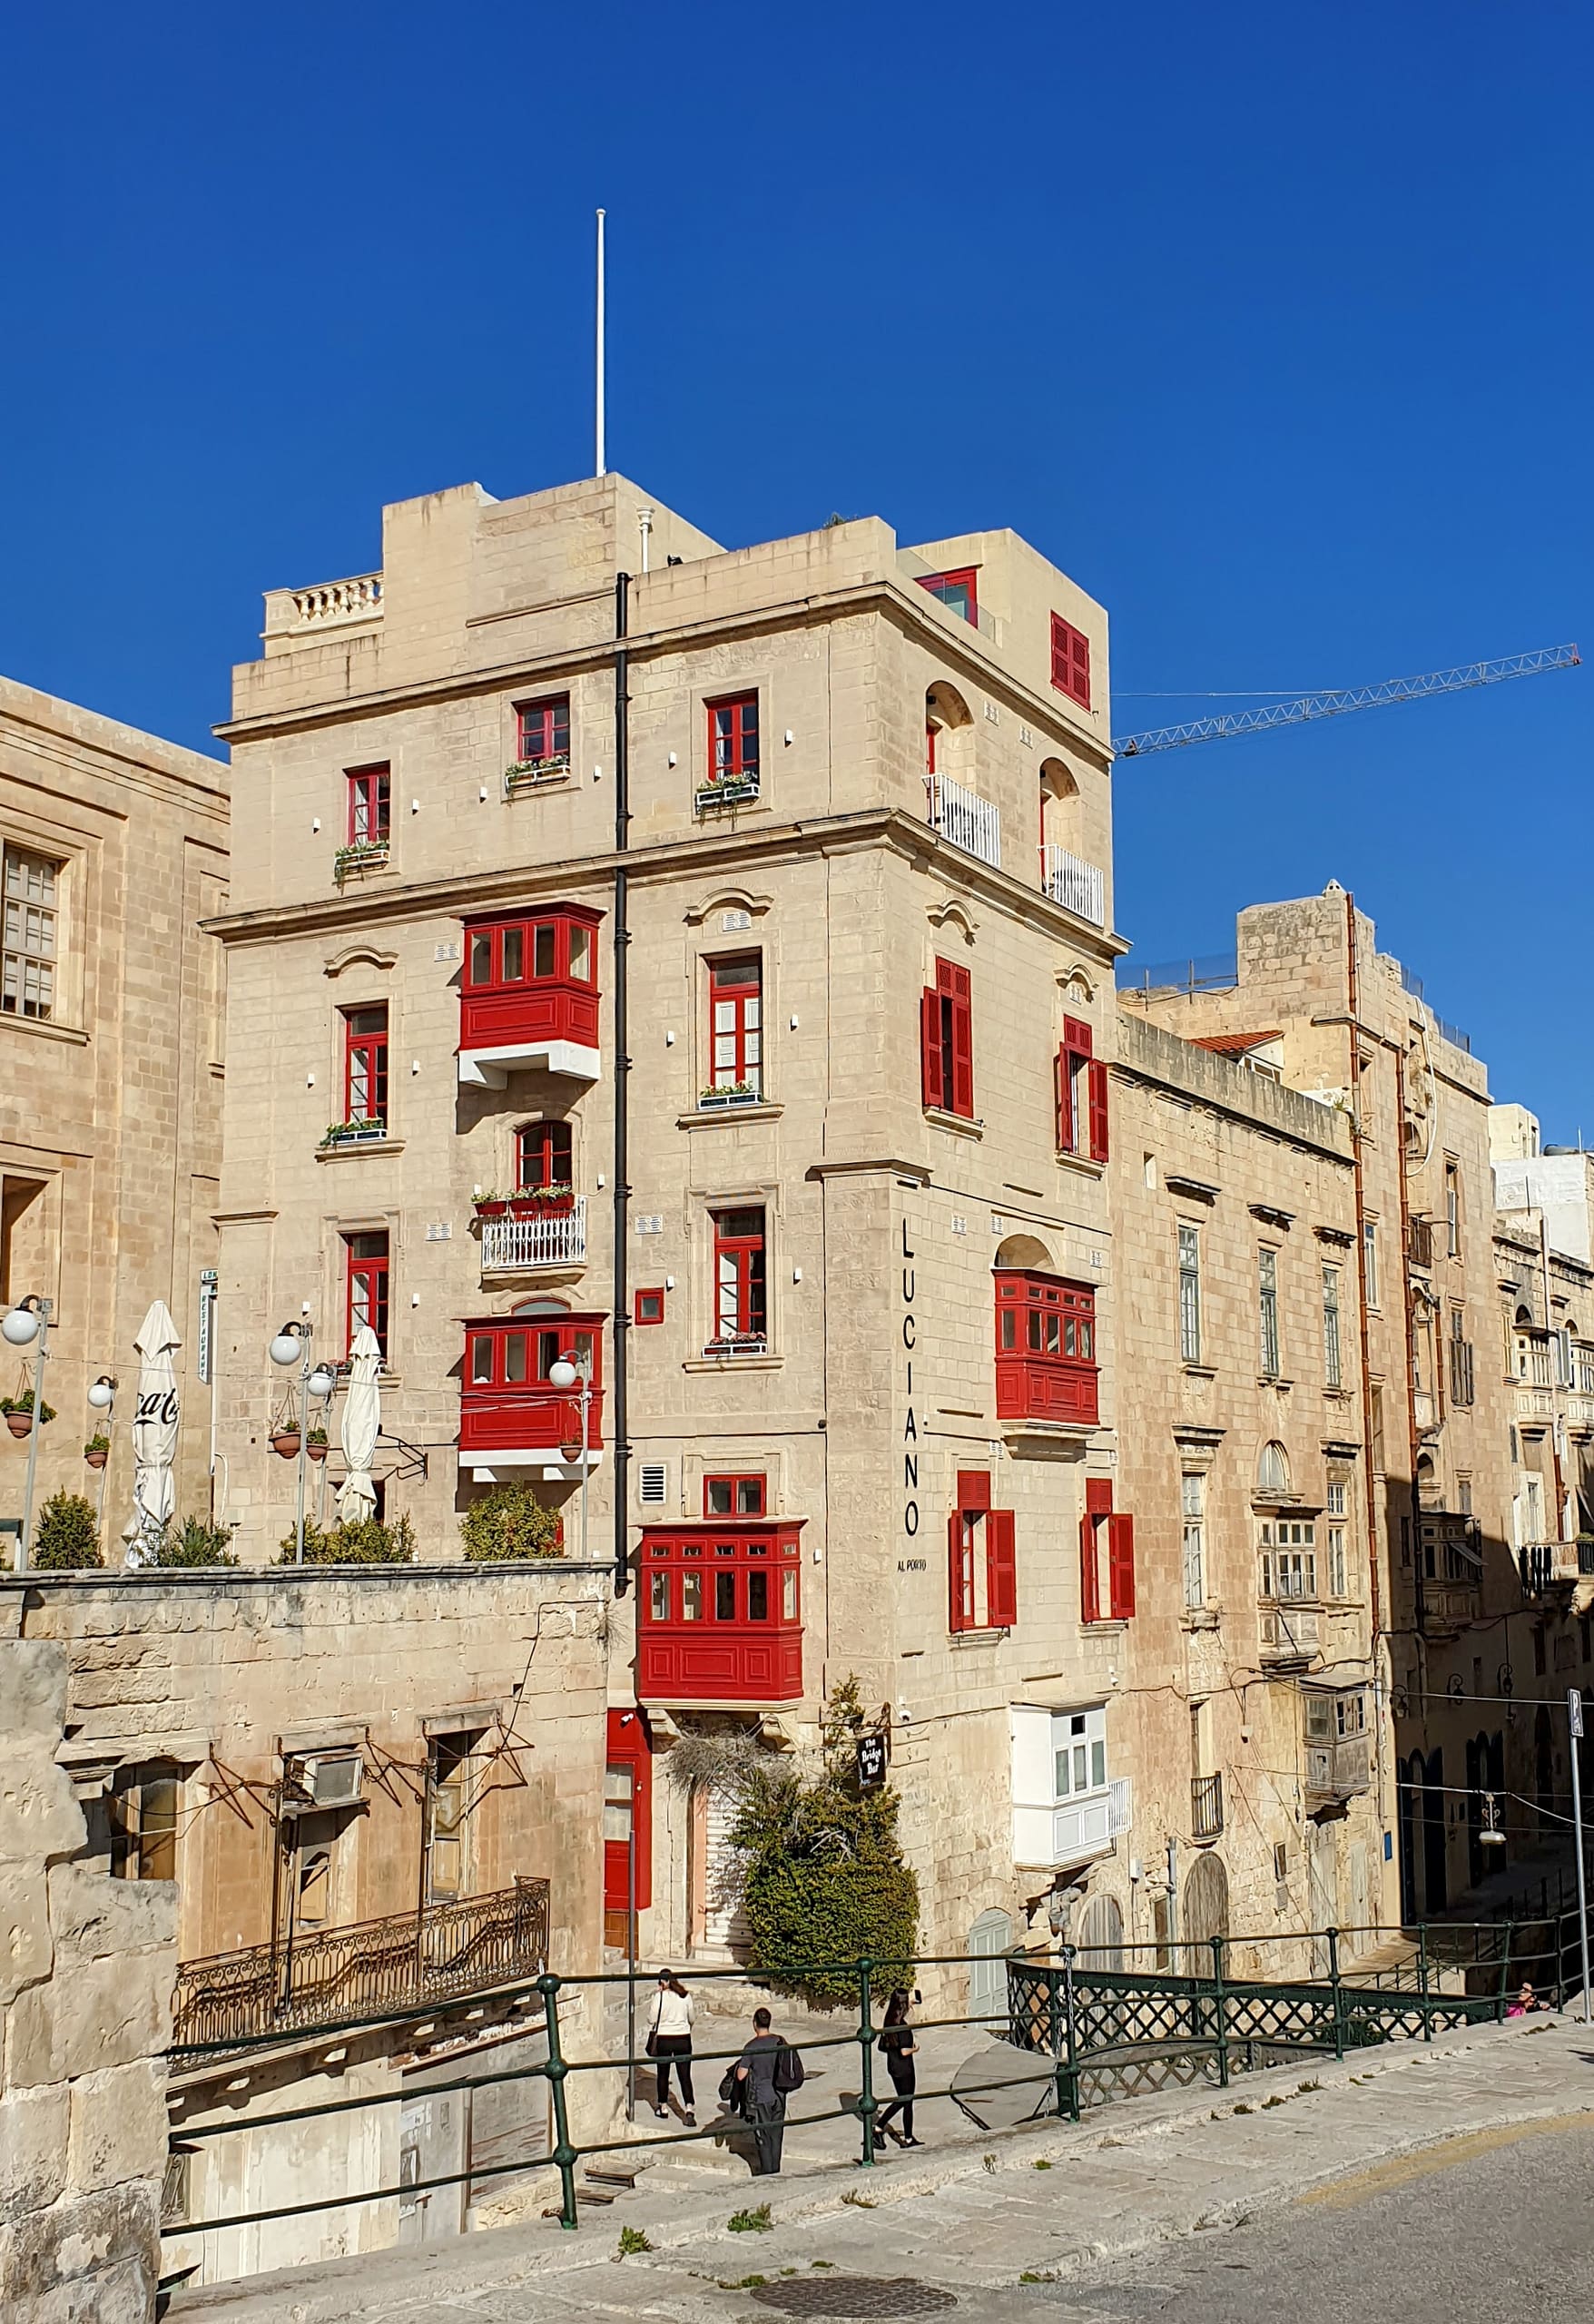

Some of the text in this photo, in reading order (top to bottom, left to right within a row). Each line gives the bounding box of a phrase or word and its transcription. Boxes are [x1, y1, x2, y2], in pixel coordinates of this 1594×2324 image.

[902, 1217, 919, 1537] LUCIANO
[1572, 1692, 1579, 1718] P
[865, 1738, 877, 1748] The
[861, 1748, 882, 1763] Bridge
[867, 1762, 880, 1775] Bar
